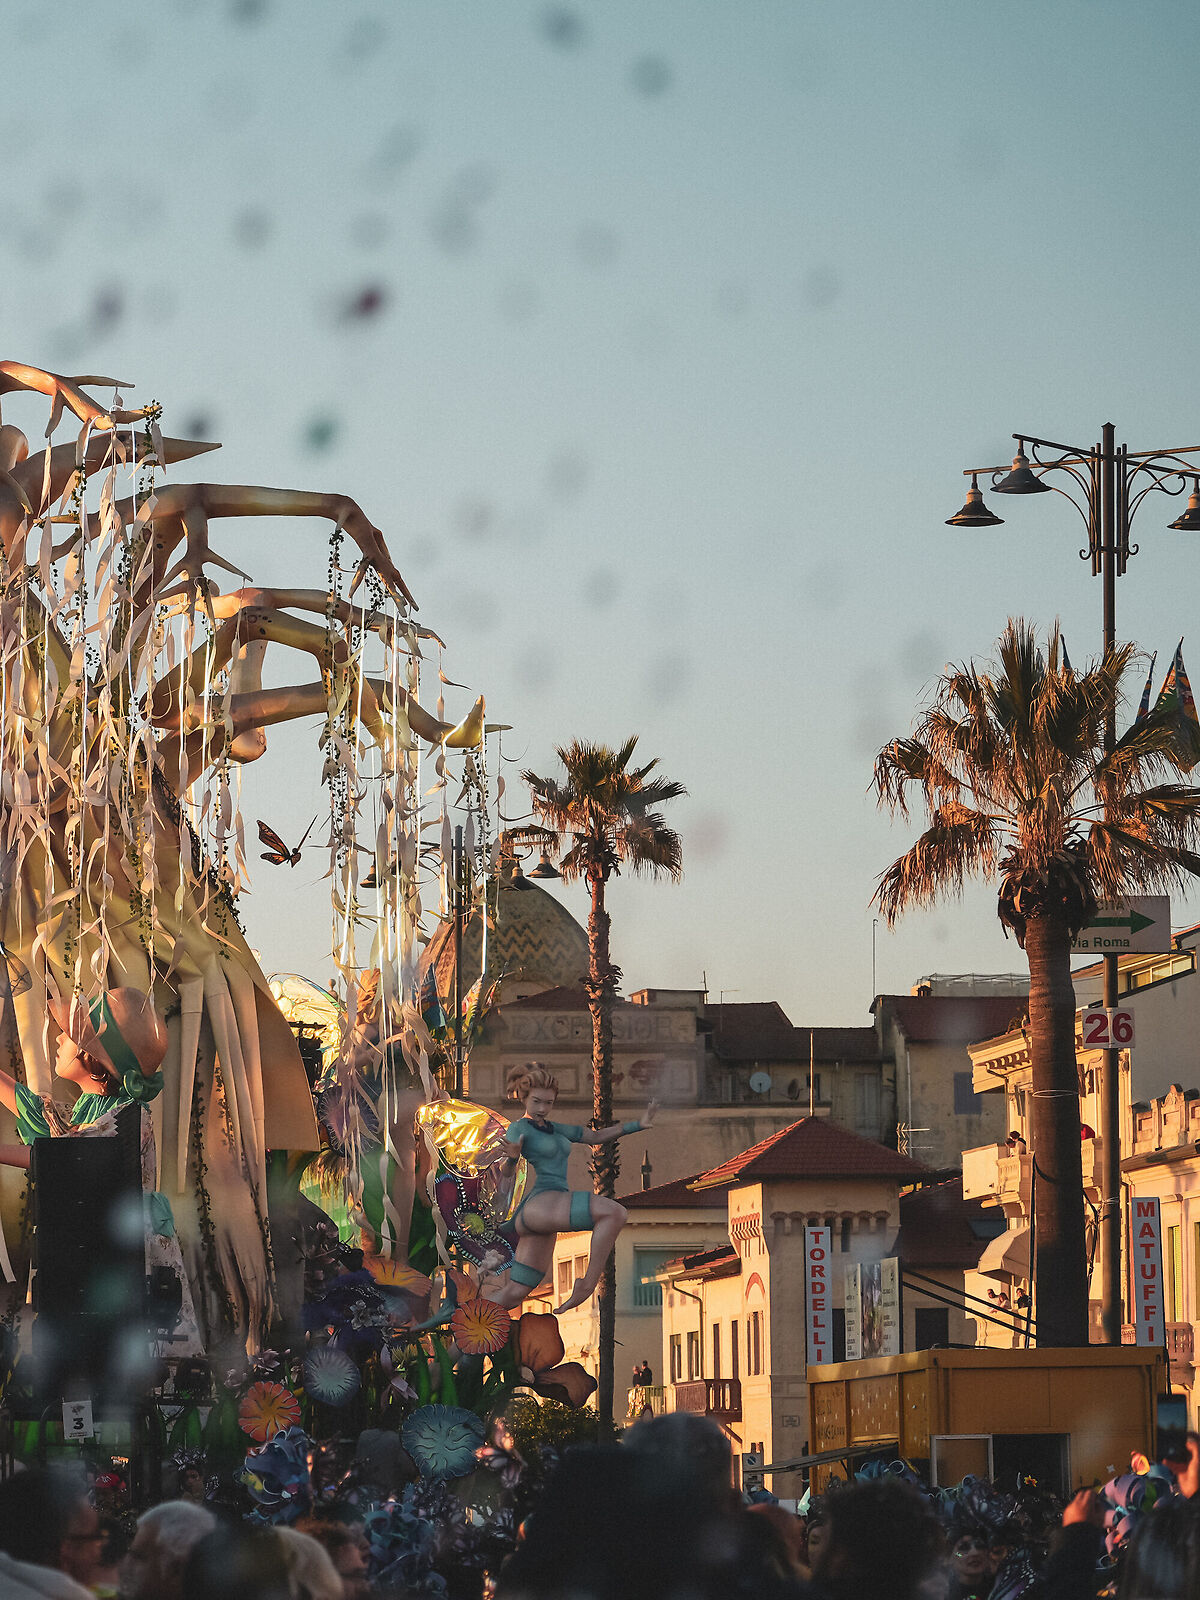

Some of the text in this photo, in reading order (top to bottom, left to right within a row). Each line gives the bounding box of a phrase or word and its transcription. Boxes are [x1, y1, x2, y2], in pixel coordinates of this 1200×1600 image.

[1071, 937, 1130, 948] Via Roma
[511, 1015, 671, 1041] EXCESIOR
[1085, 1013, 1133, 1044] 26
[1136, 1201, 1157, 1342] MATUFFI
[810, 1231, 826, 1362] TORDELLI
[72, 1417, 85, 1430] 3
